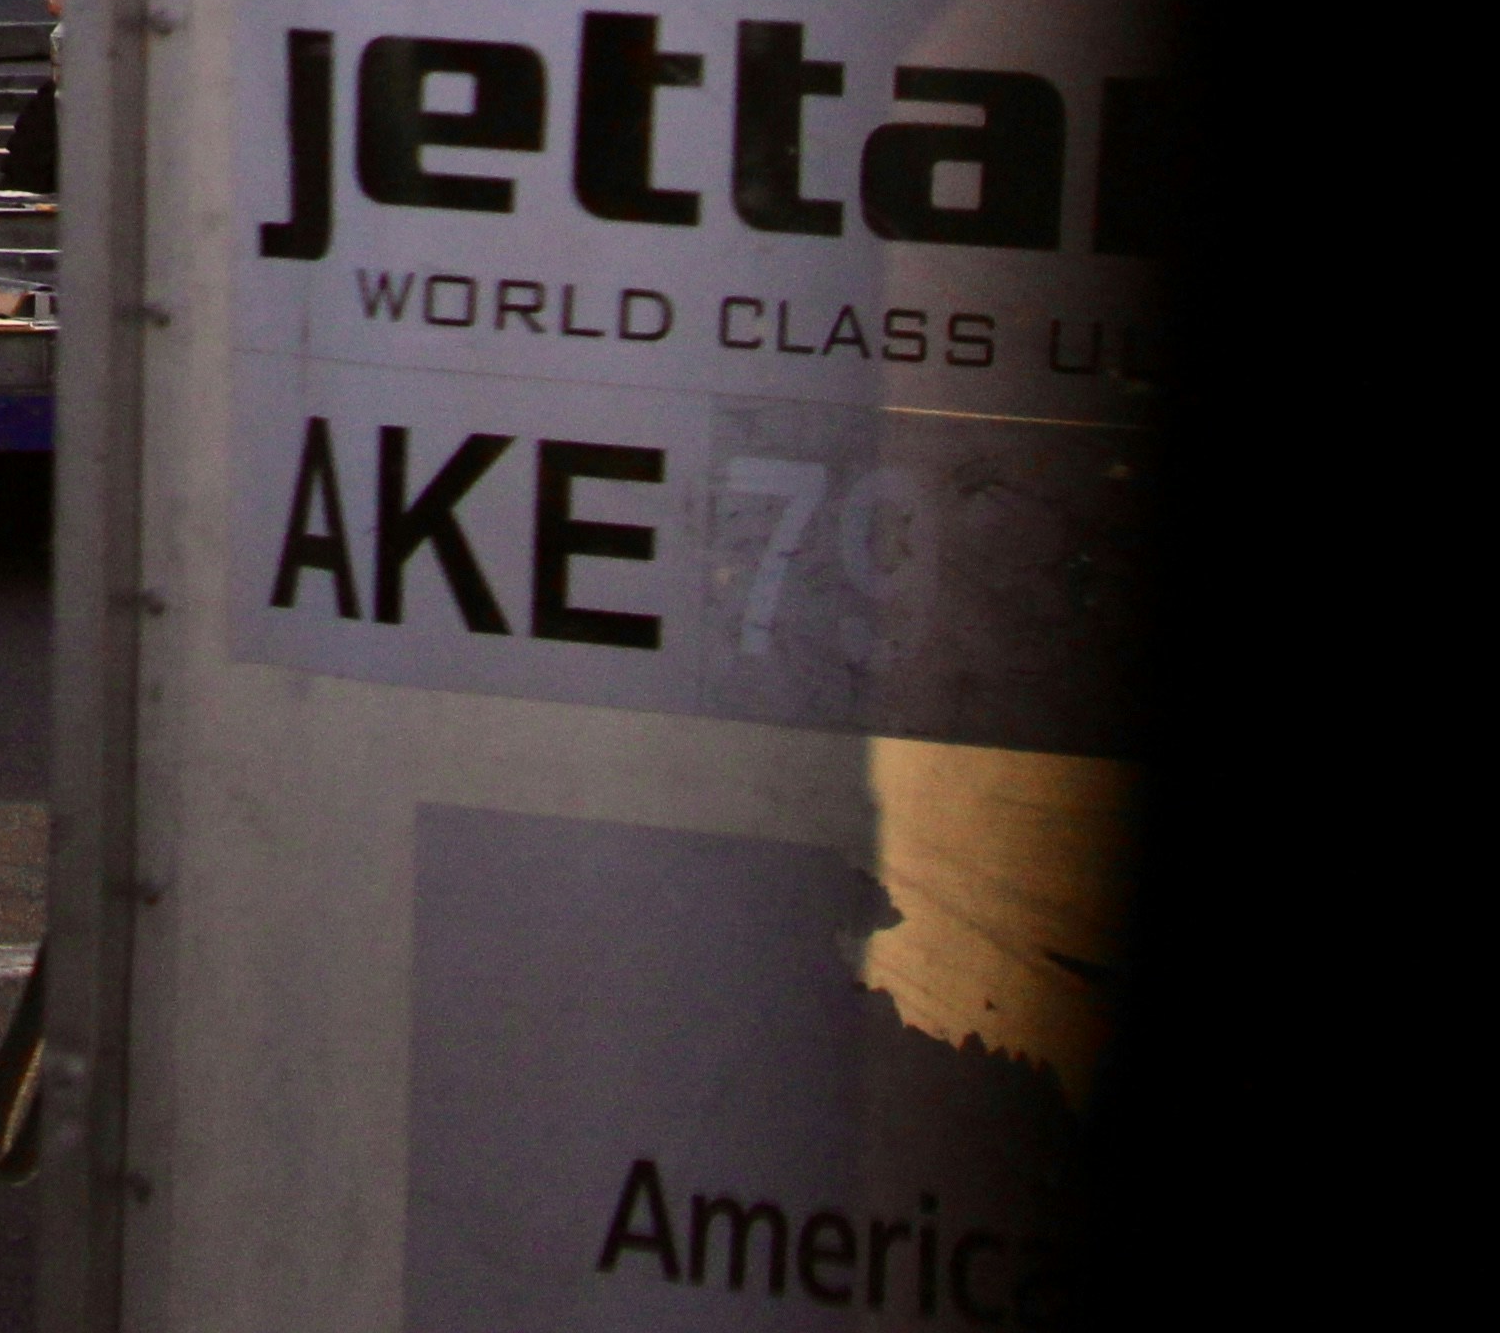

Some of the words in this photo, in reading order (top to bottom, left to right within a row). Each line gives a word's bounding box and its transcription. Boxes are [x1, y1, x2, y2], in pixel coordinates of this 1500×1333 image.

[357, 267, 674, 342] WORLD
[719, 295, 995, 369] CLASS
[269, 415, 666, 651] AKE
[596, 1157, 1060, 1317] Americ
